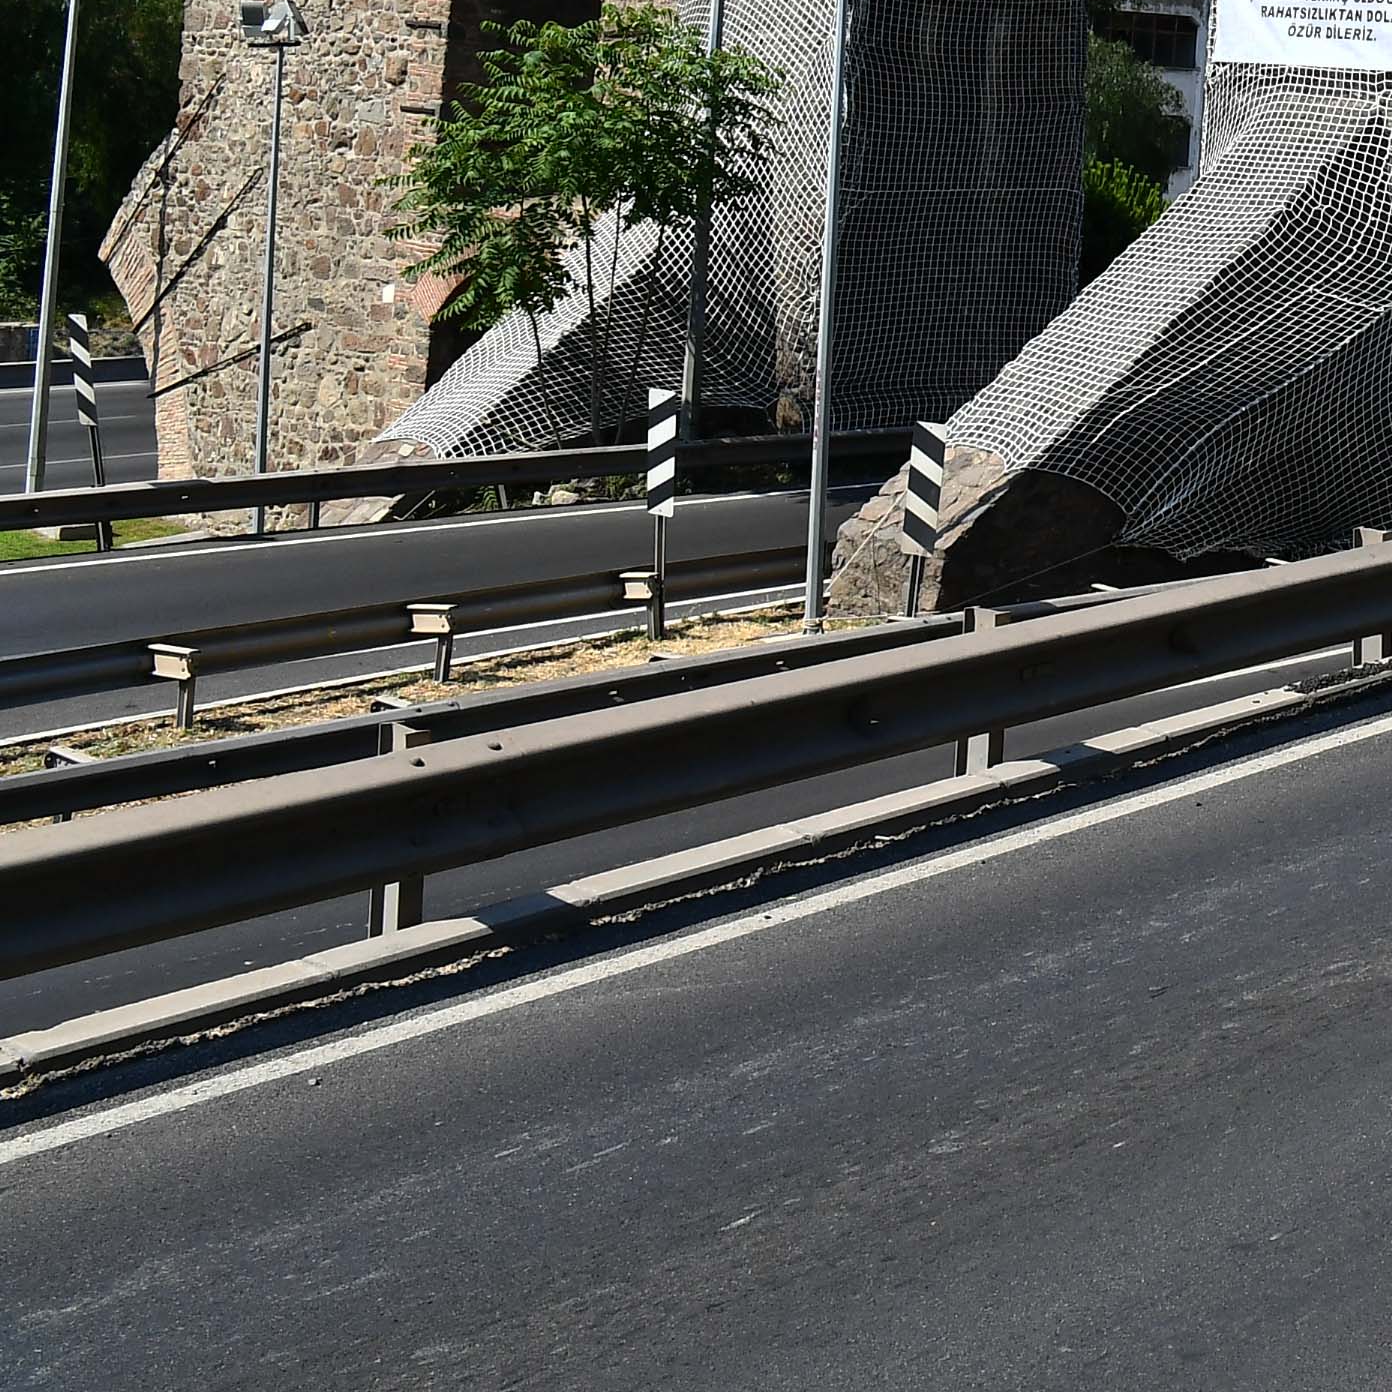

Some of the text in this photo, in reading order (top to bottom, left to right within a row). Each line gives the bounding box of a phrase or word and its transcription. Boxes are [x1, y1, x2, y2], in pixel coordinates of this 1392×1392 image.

[1260, 5, 1363, 23] RAHATSIZLIKTAN
[1287, 22, 1377, 43] ÖZÜR DİLERİZ.
